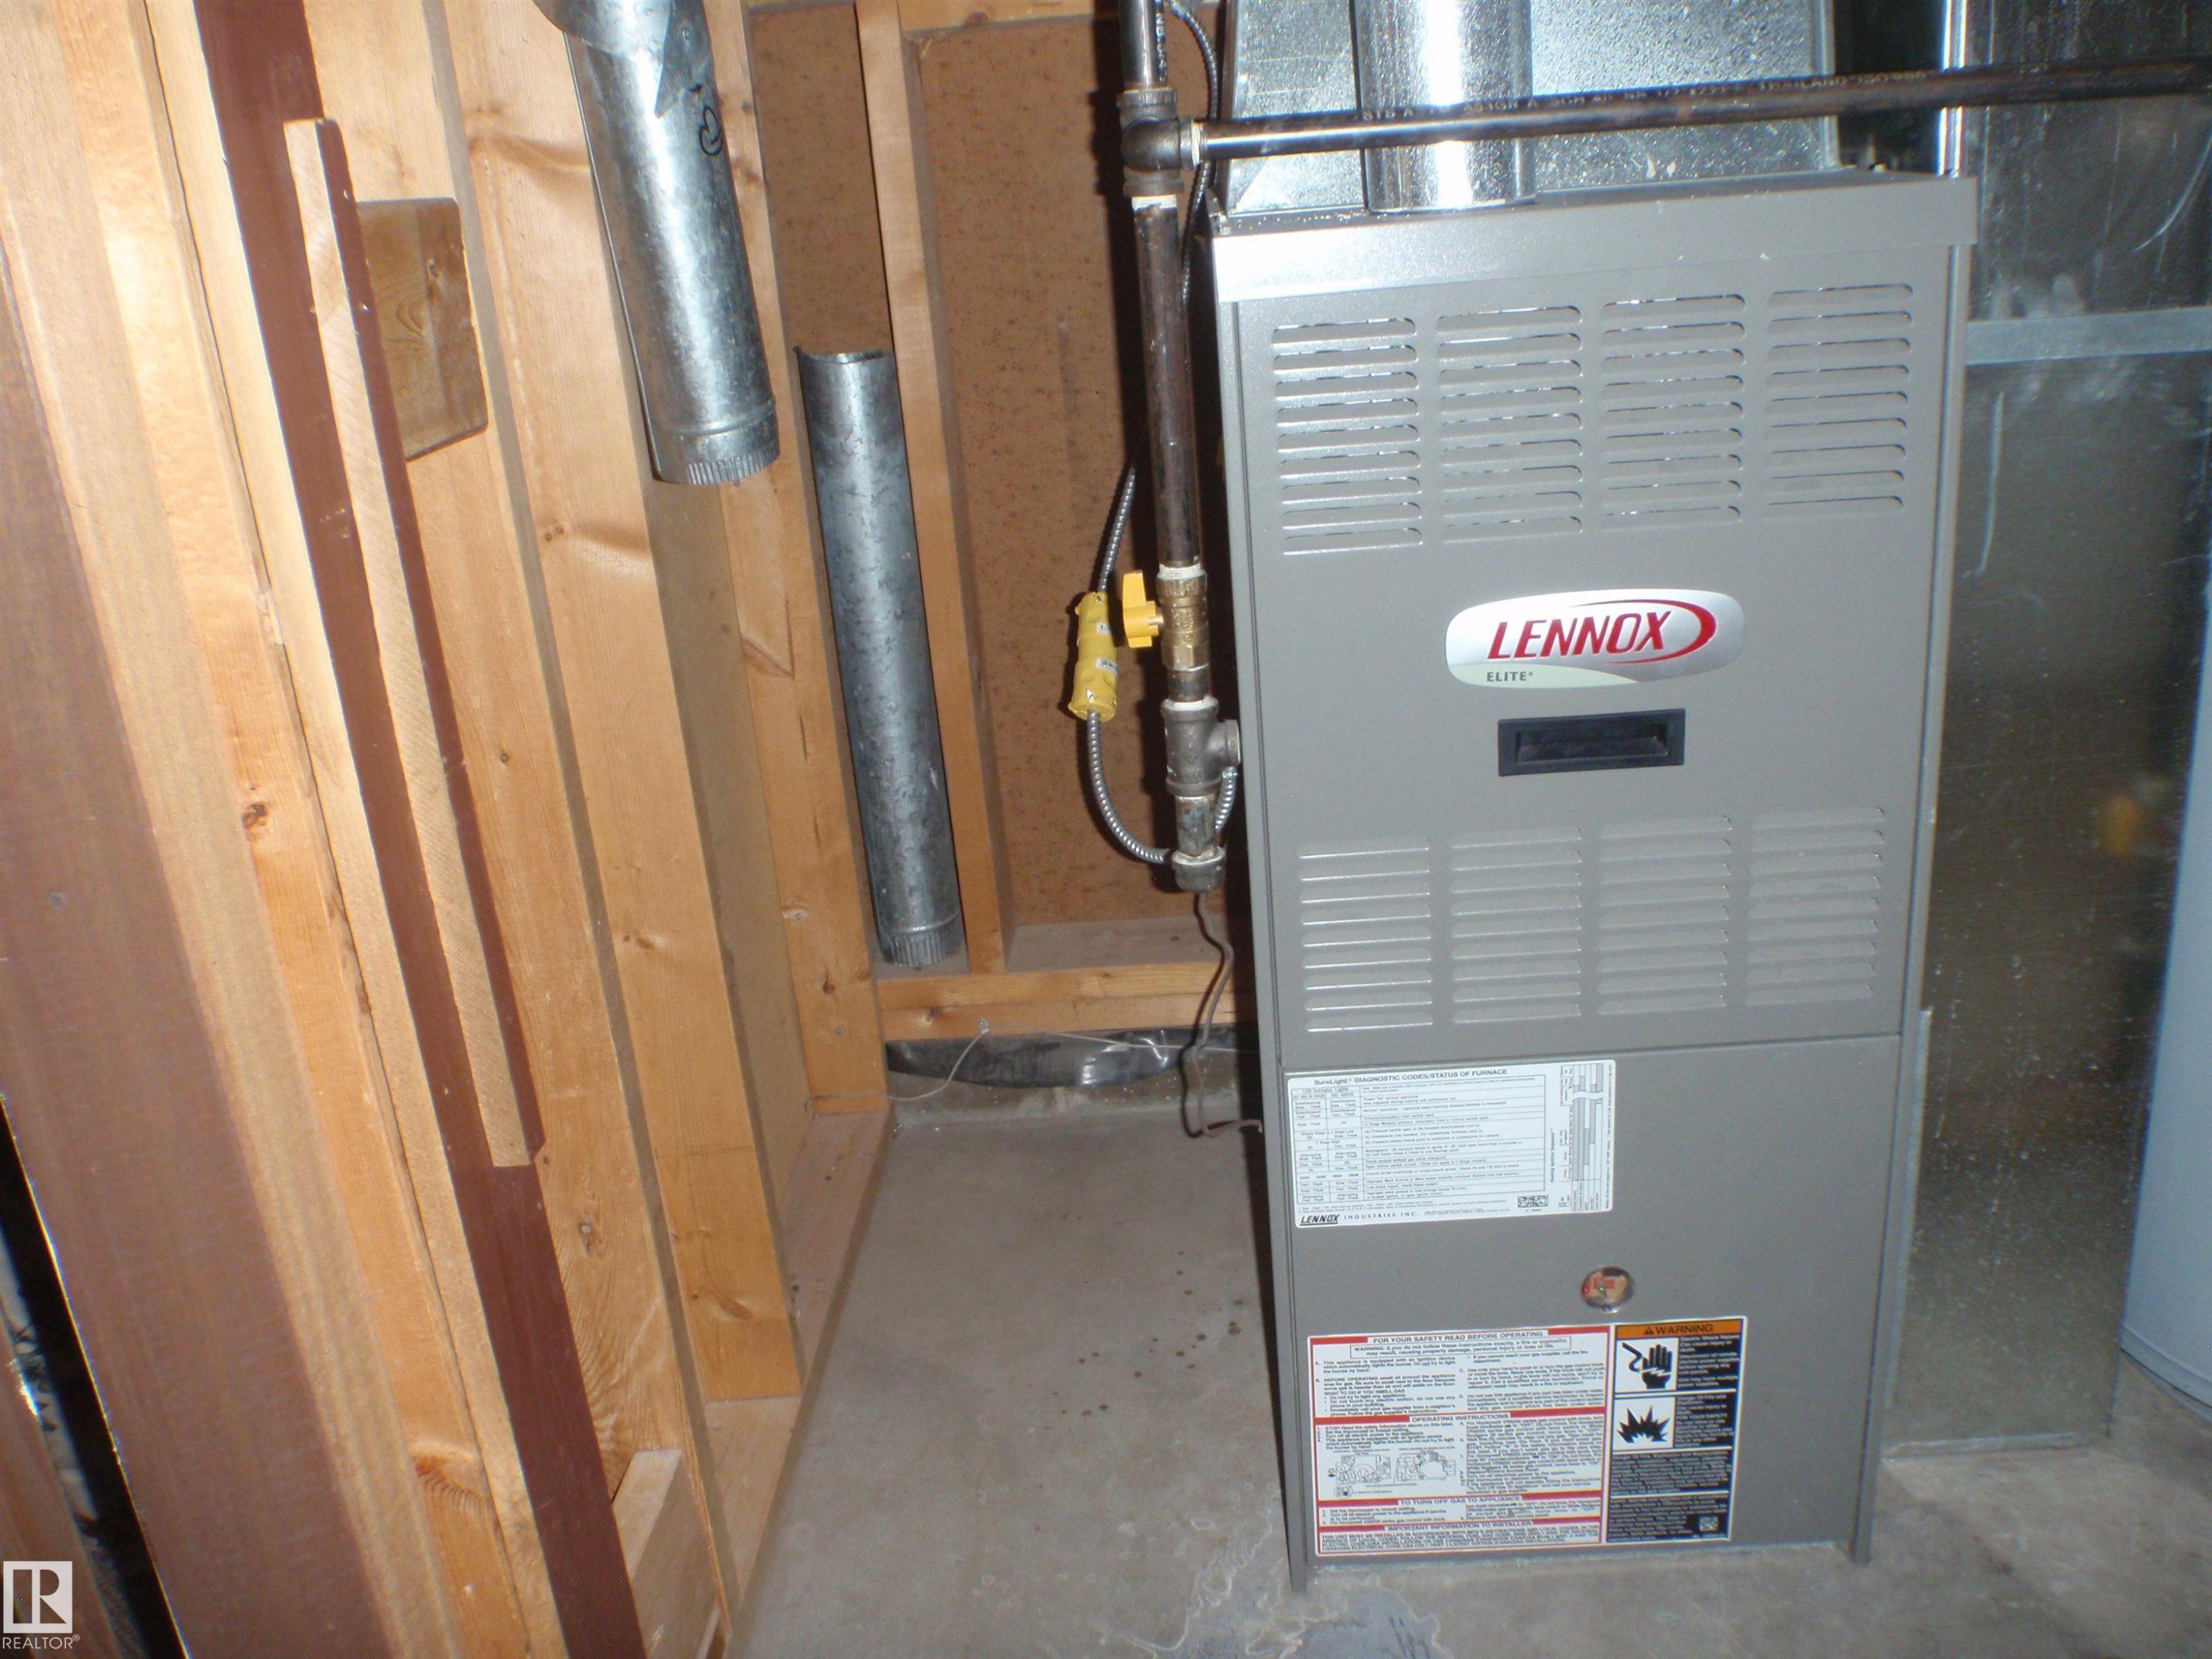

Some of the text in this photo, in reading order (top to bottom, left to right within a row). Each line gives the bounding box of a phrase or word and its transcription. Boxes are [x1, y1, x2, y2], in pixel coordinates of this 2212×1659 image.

[1487, 611, 1672, 660] LENNOX
[1402, 1071, 1457, 1080] CODES/STATUS
[1300, 1214, 1339, 1224] LENNOX
[1655, 1324, 1714, 1335] WARNING
[1455, 1413, 1508, 1421] INSTRUCTIONS
